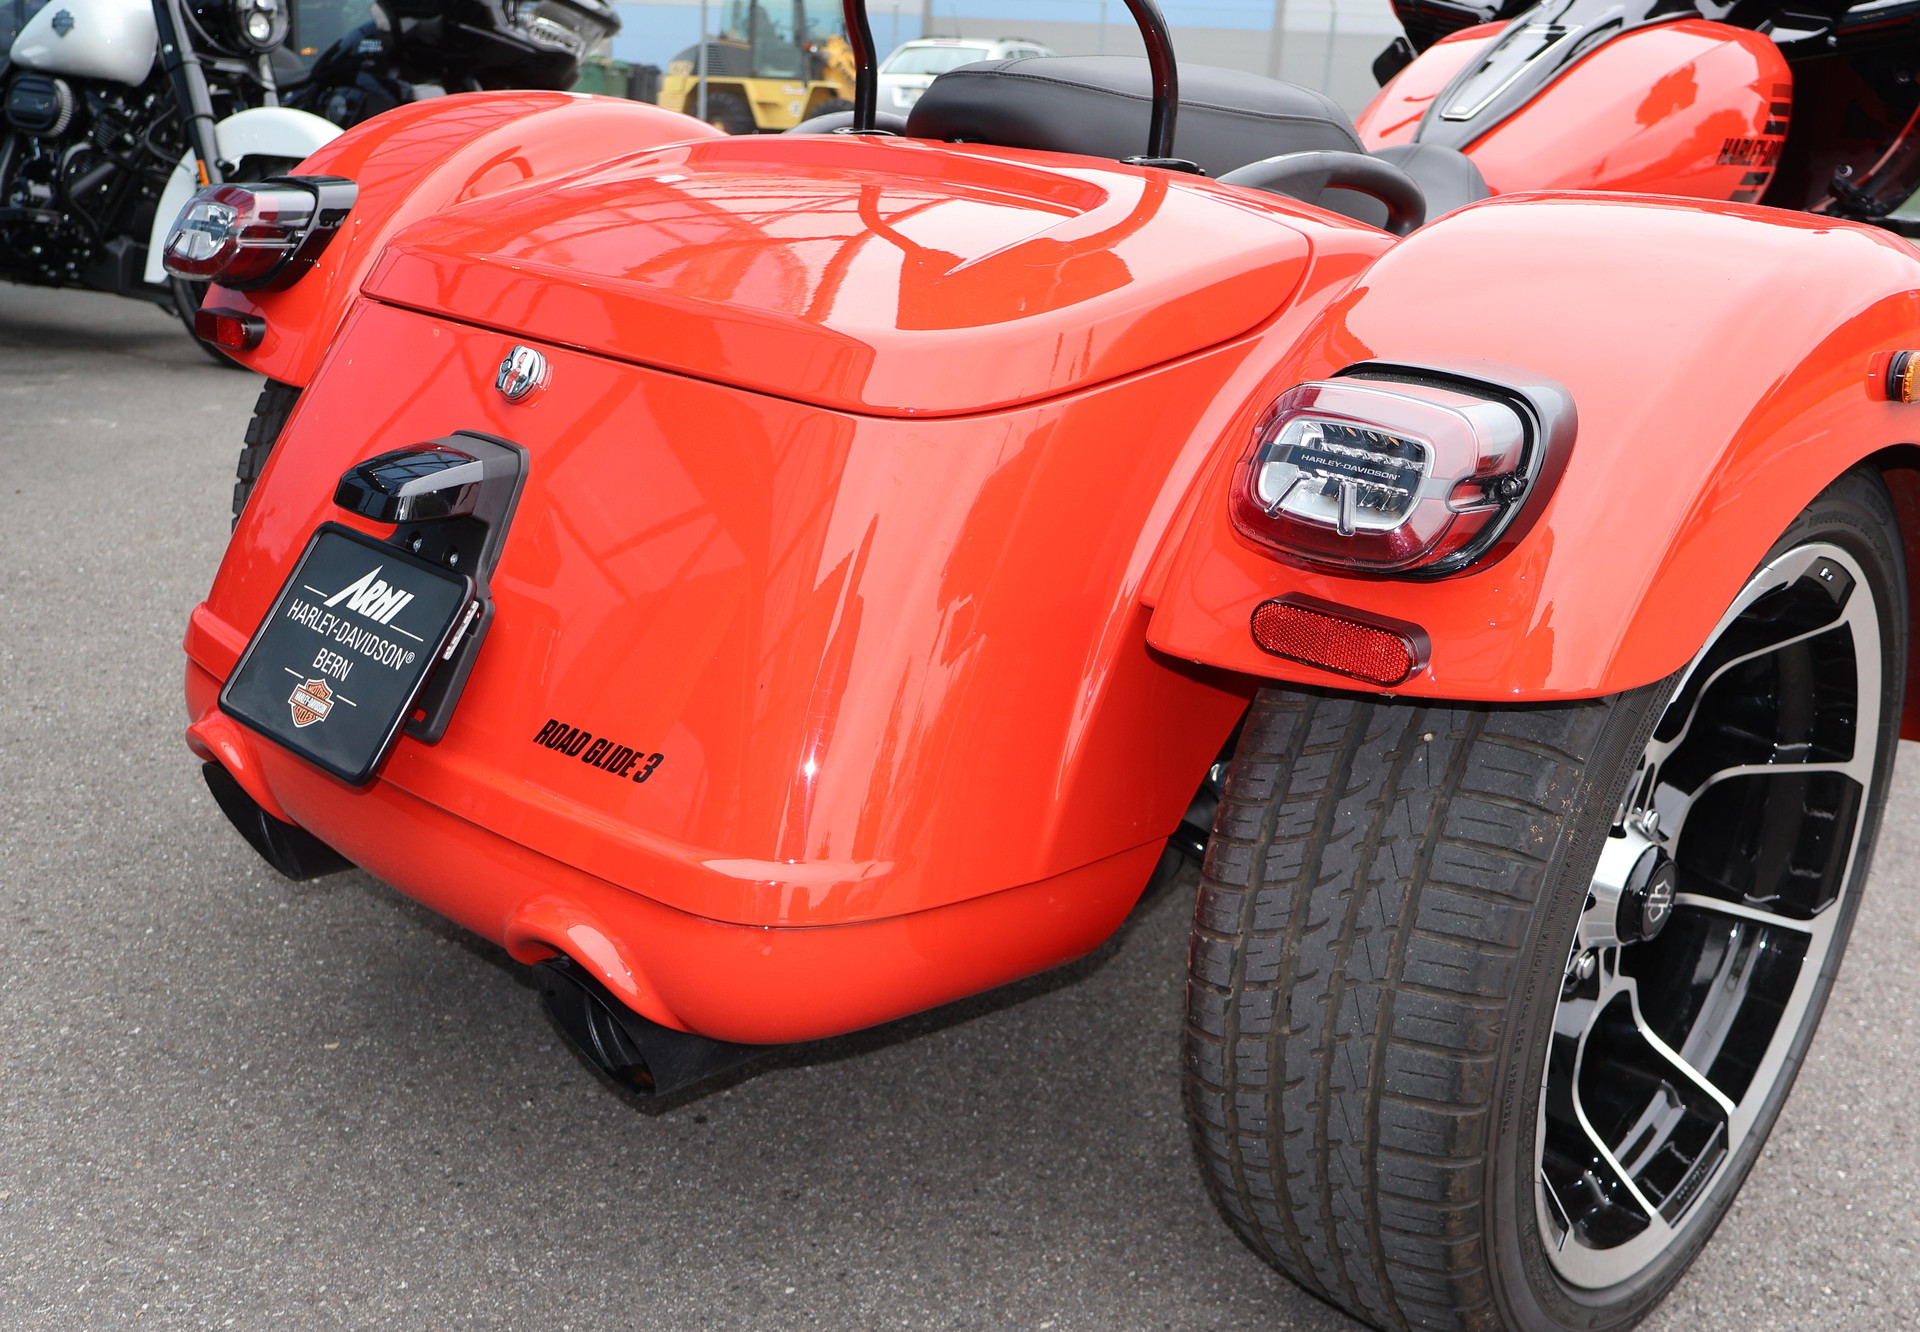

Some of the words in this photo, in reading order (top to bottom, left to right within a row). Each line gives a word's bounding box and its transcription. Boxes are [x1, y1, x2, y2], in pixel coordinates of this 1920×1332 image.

[1301, 454, 1400, 480] HARLEY-DAVIDSON
[322, 564, 415, 625] ARNI
[312, 647, 354, 682] BERN
[532, 718, 592, 757] ROAD
[581, 737, 645, 778] GLIDE
[632, 752, 665, 784] 3
